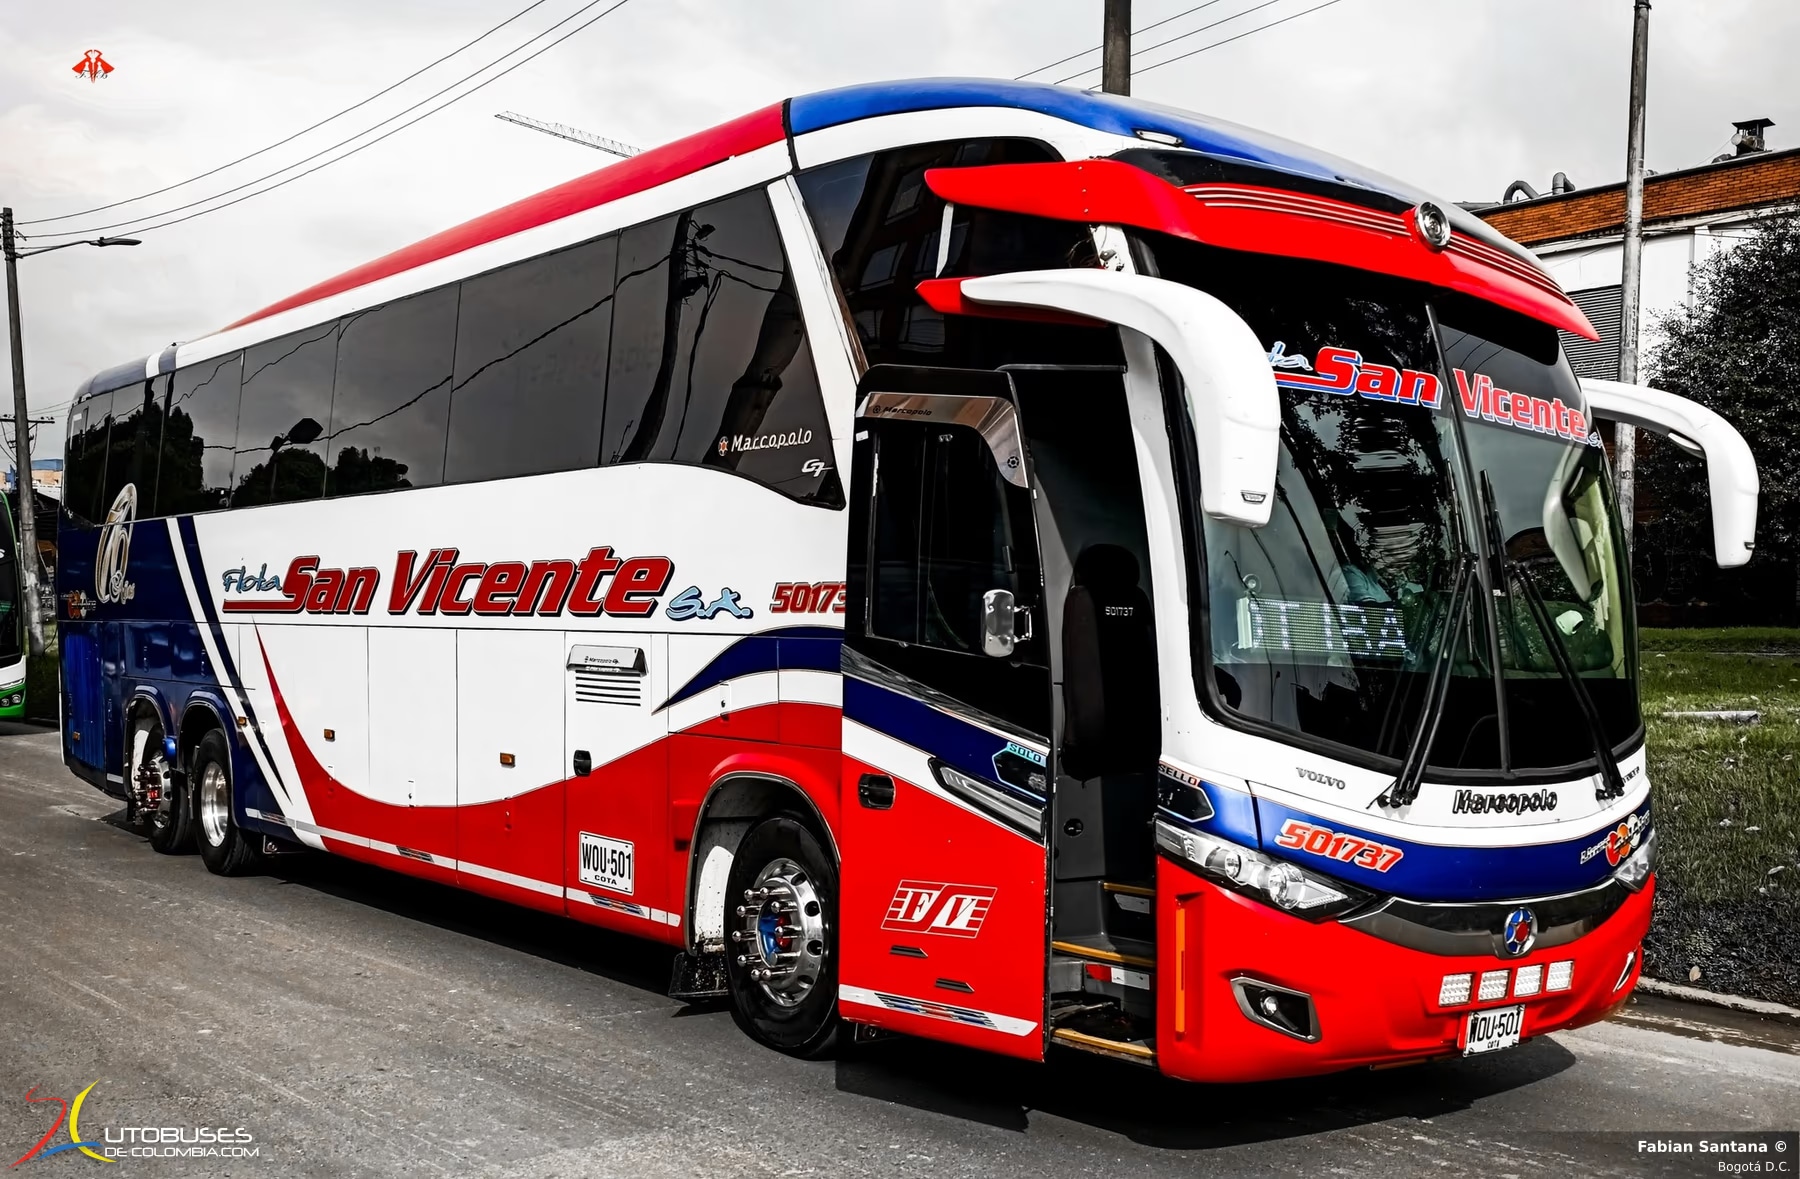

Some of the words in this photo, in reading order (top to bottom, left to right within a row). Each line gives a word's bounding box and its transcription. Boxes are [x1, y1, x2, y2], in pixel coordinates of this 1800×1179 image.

[1308, 346, 1443, 410] San
[1452, 367, 1589, 445] Vicente
[883, 406, 933, 416] Marcopolo
[731, 428, 812, 452] Marcopolo
[222, 563, 283, 594] Flota
[278, 555, 380, 615] San
[387, 545, 675, 618] Vicente
[1010, 743, 1042, 763] SOLO
[1159, 763, 1198, 786] SELLO
[1295, 766, 1346, 790] VOLVO
[1452, 788, 1558, 816] Marcopolo
[1274, 818, 1404, 873] 501737
[594, 874, 617, 886] COTA
